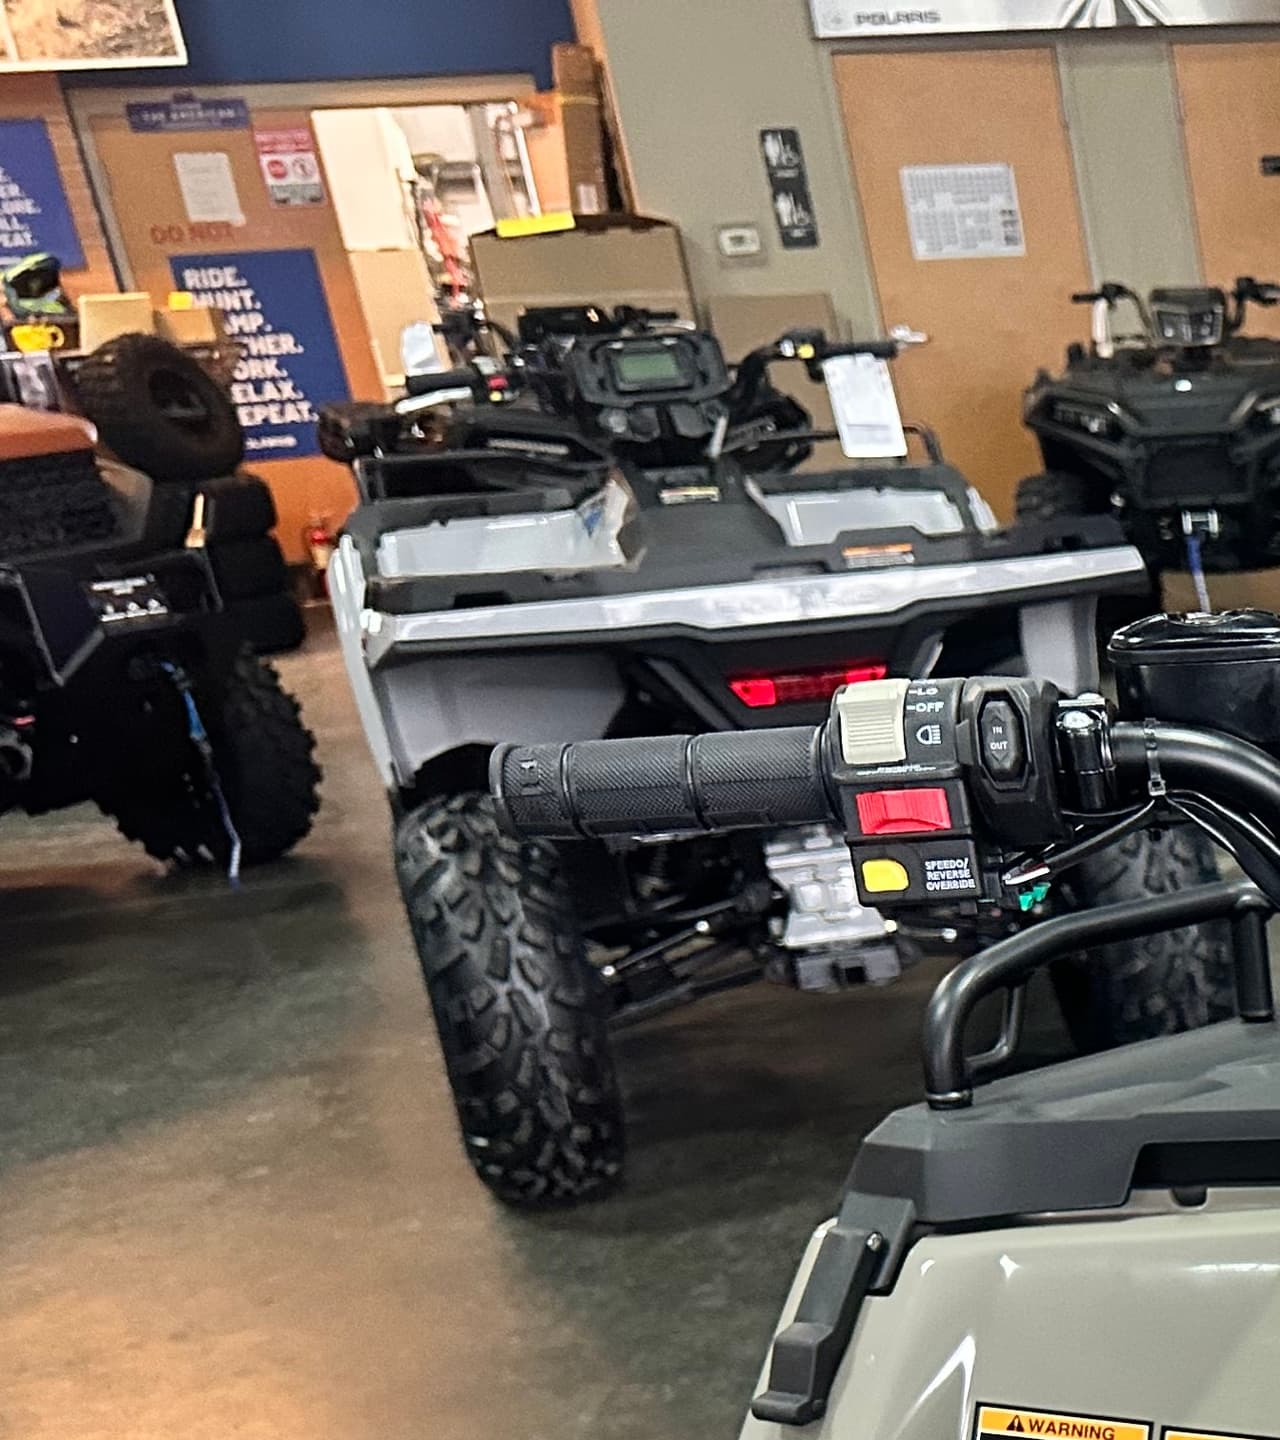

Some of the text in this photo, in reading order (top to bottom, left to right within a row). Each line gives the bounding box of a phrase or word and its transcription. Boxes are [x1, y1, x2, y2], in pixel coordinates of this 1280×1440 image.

[855, 9, 941, 25] POLARIS
[183, 267, 248, 289] RIDE.
[233, 358, 288, 381] ORK.
[231, 379, 304, 404] ELAX.
[236, 401, 320, 427] EPEAT.
[915, 701, 945, 713] OFF
[989, 741, 1009, 751] OUT
[924, 857, 970, 871] SPEEDO/
[926, 868, 971, 881] REVERSE
[926, 878, 976, 891] OVERRIDE
[1027, 1418, 1116, 1440] WARNING
